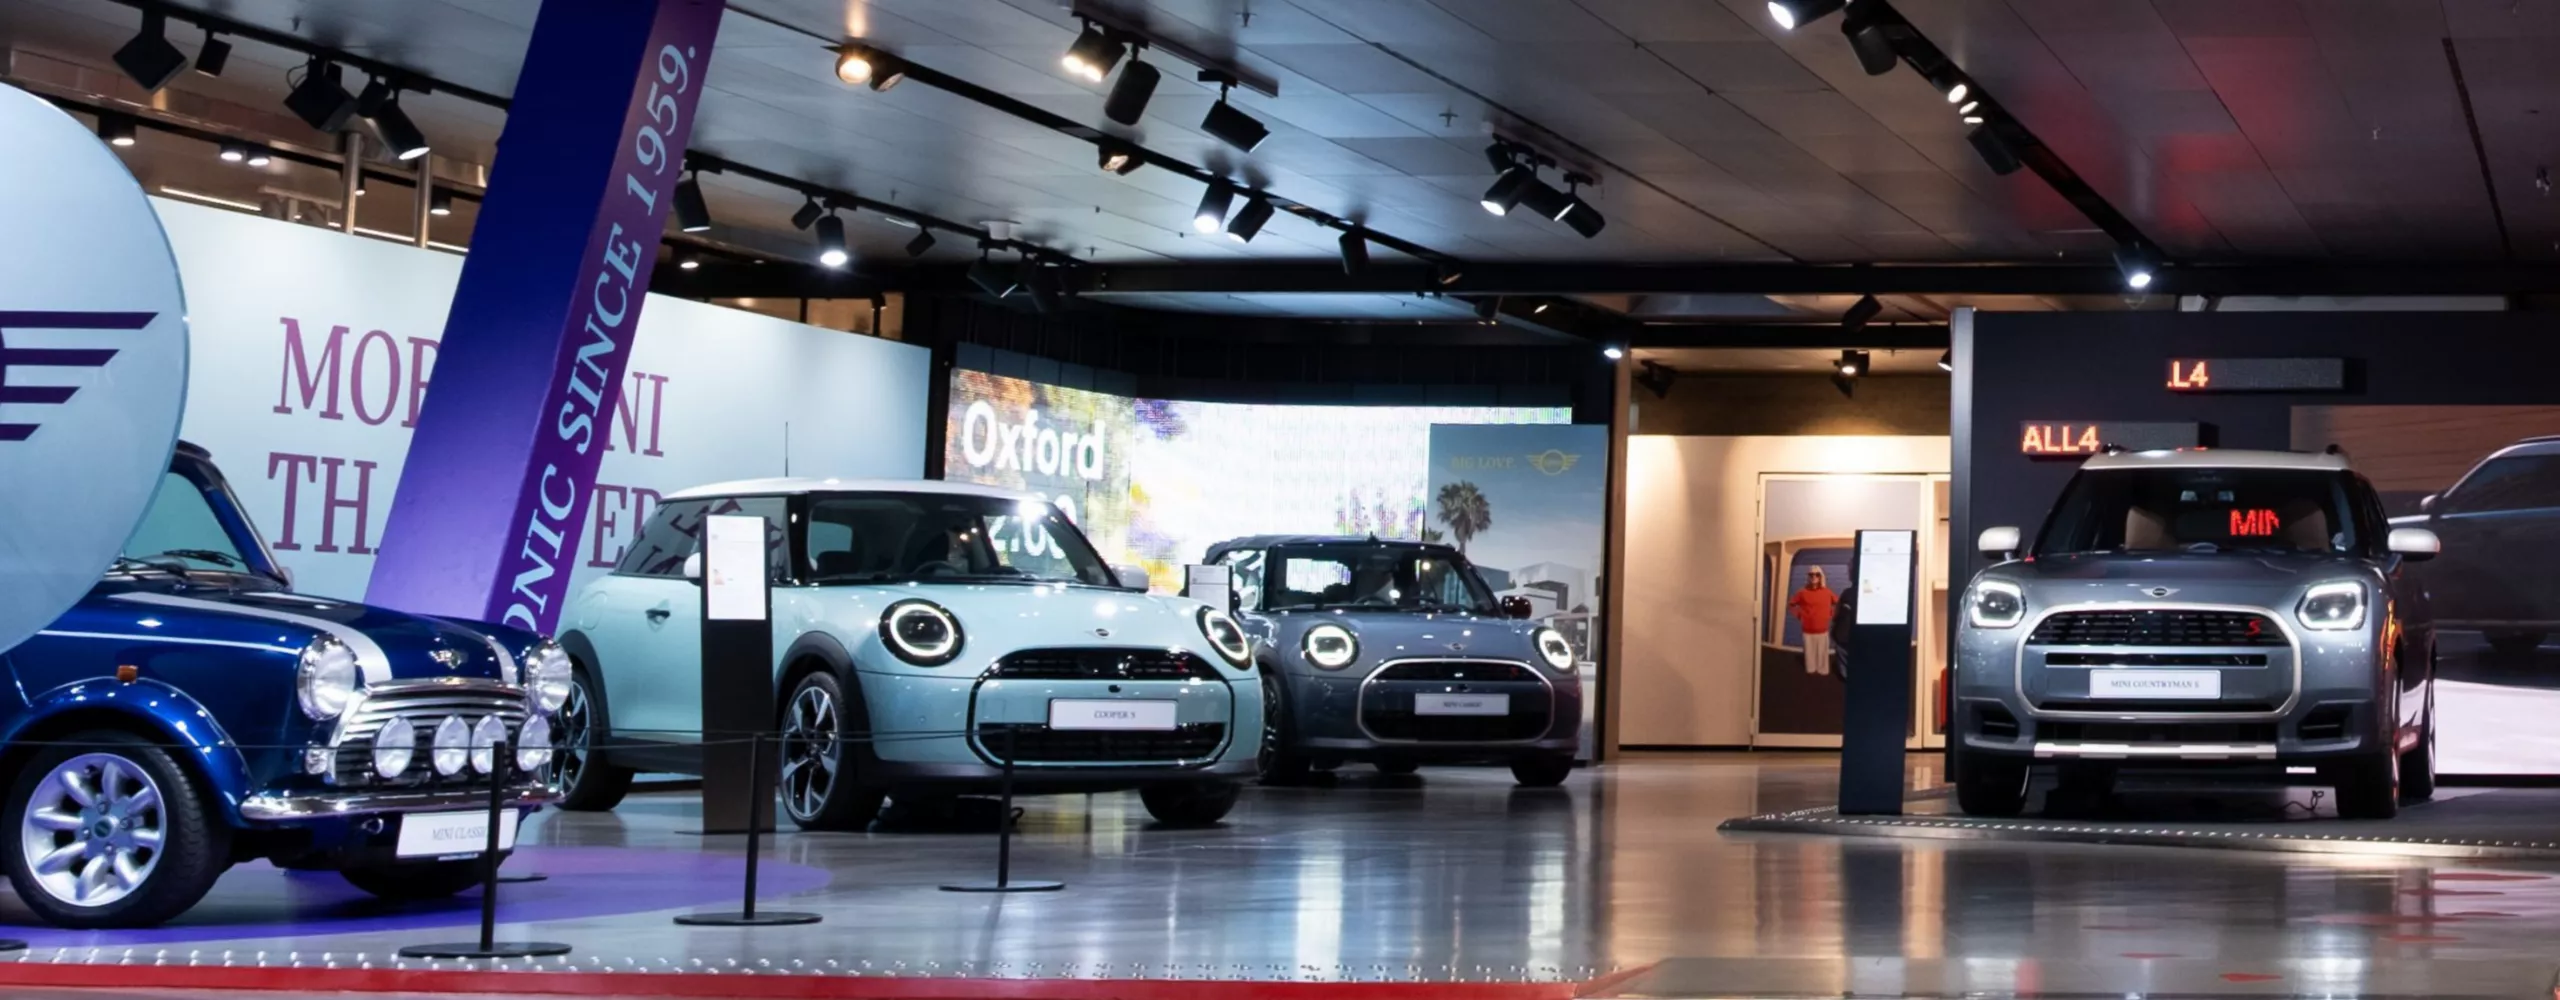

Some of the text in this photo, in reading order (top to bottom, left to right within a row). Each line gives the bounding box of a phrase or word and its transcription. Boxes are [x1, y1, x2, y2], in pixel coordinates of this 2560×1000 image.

[502, 44, 695, 633] ONIC SINCE 1959.
[273, 316, 669, 458] MOR NI
[963, 400, 1106, 480] Oxford
[2022, 424, 2099, 453] ALL4
[267, 451, 379, 555] TH
[455, 826, 487, 840] CLASSI
